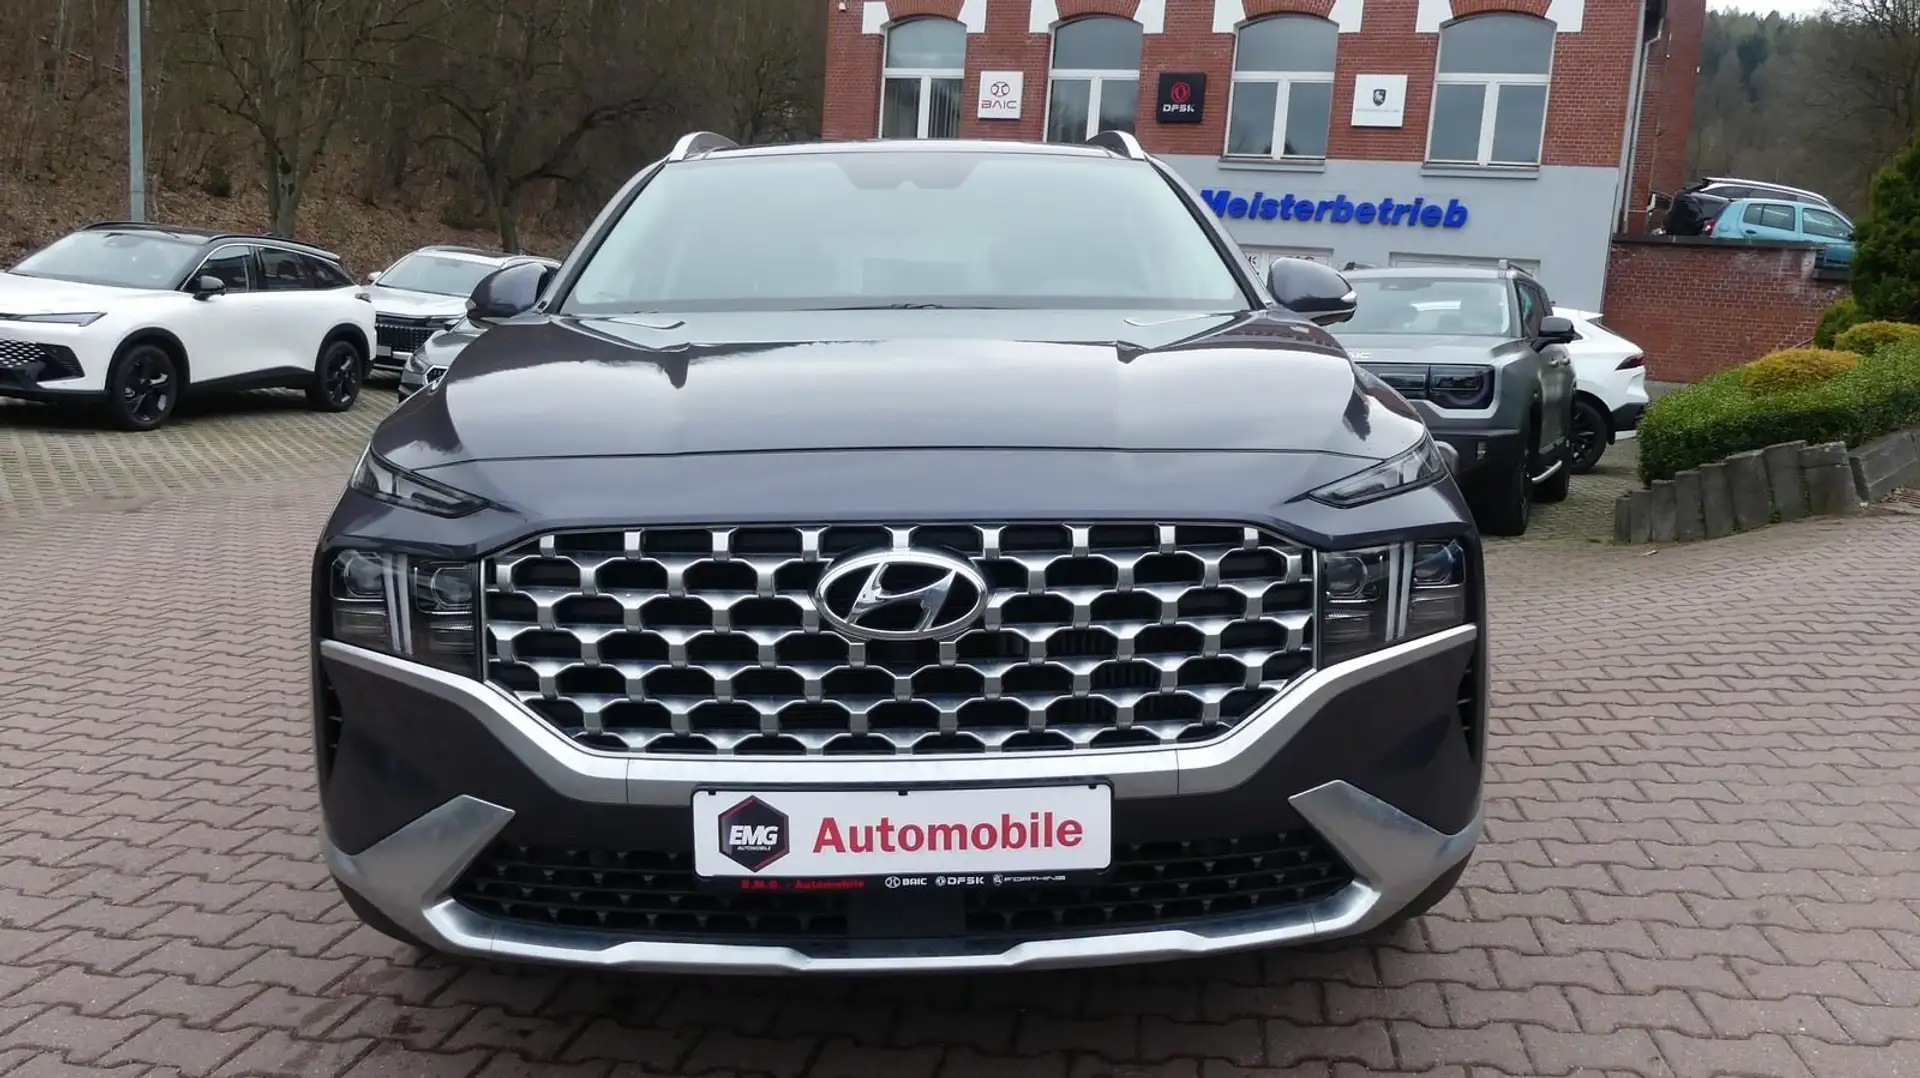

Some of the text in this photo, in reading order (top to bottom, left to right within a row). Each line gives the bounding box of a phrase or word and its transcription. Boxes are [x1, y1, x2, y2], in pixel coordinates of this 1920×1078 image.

[981, 100, 1017, 109] BAIC
[1162, 103, 1196, 112] DFSK
[1200, 189, 1469, 229] Meisterbetrieb
[729, 825, 779, 846] EMG
[812, 811, 1084, 854] Automobile
[902, 877, 928, 887] BAIC
[947, 876, 985, 886] DFSK
